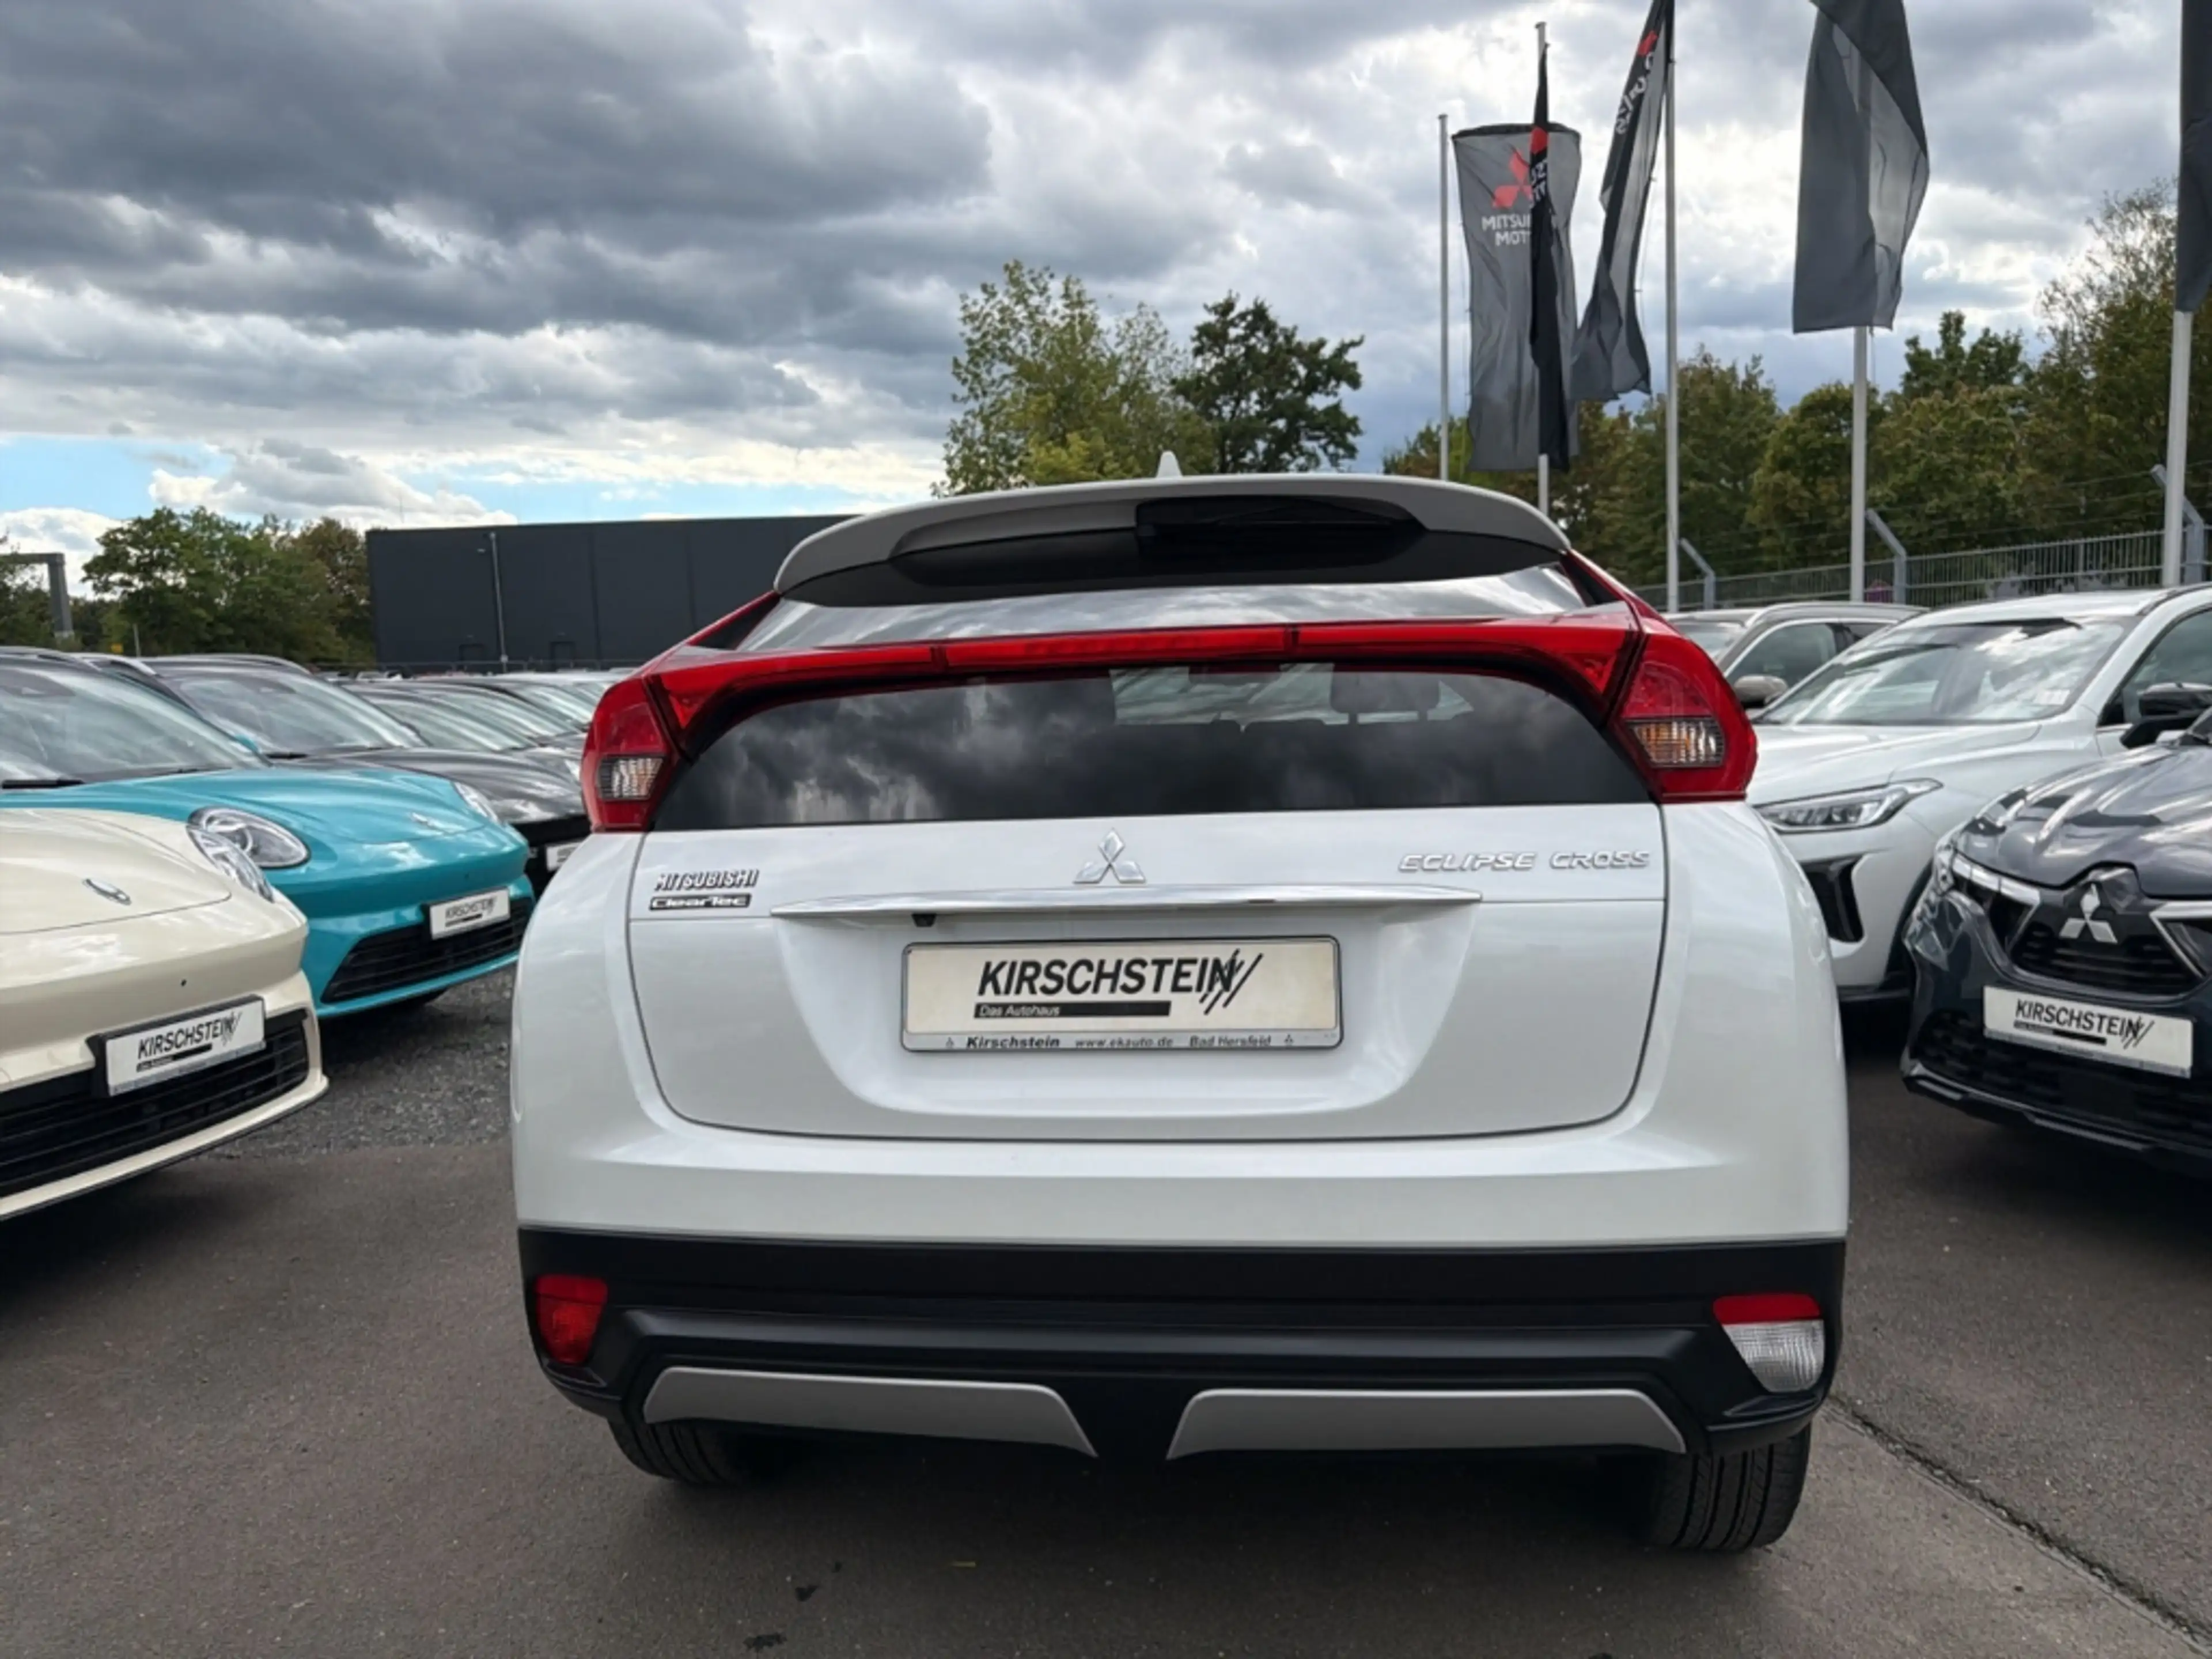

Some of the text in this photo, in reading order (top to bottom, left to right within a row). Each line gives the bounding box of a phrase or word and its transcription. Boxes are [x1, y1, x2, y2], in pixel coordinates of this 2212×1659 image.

[1482, 214, 1531, 231] MITSU
[1495, 230, 1531, 247] MOT
[1398, 850, 1650, 872] ECLIPSE CROSS
[654, 869, 759, 891] MITSUBISHI
[978, 957, 1238, 997] KIRSCHSTEIN
[979, 1005, 1060, 1017] Das Autohaus
[2016, 998, 2142, 1038] KIRSCHSTEIN
[138, 1013, 235, 1059] KIRSCHSTEIN
[967, 1035, 1060, 1048] Kirschstein
